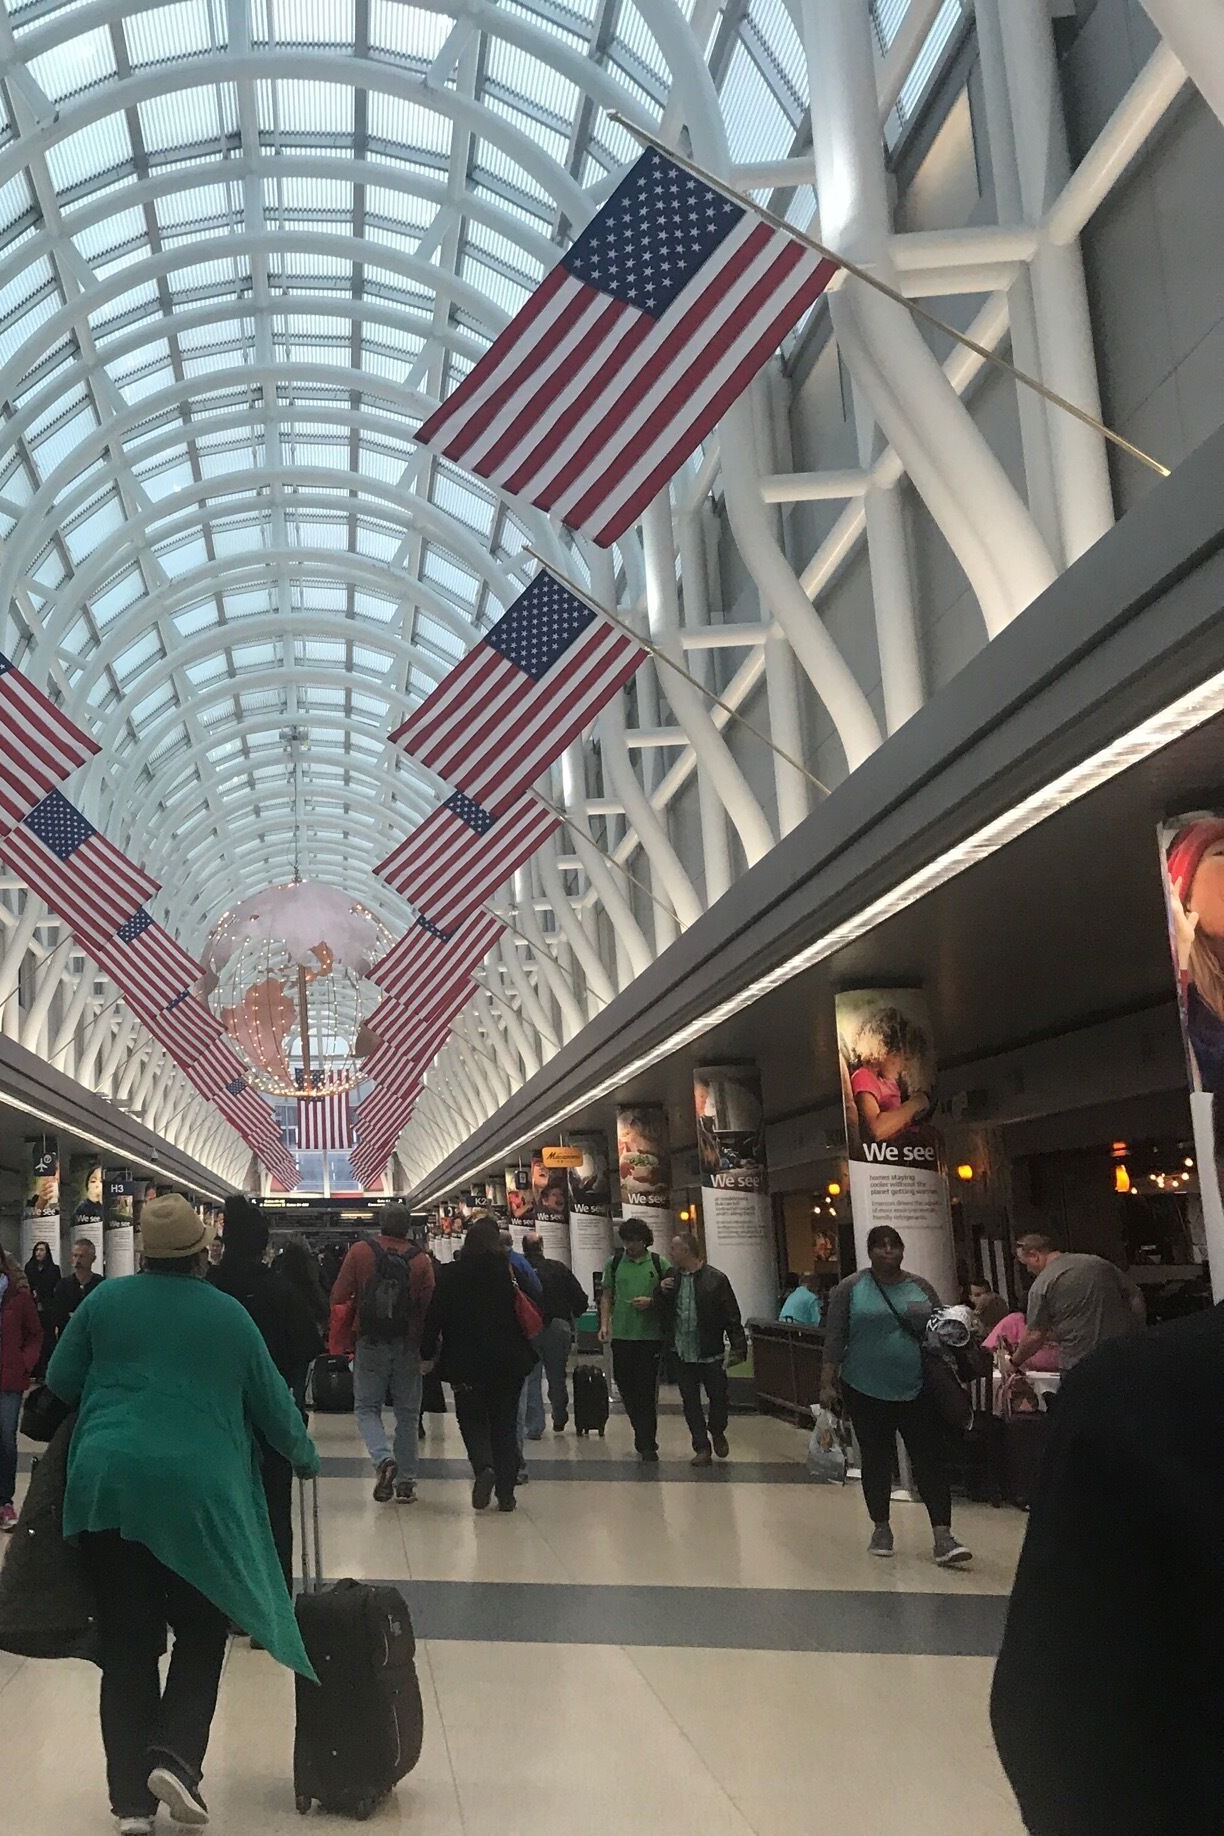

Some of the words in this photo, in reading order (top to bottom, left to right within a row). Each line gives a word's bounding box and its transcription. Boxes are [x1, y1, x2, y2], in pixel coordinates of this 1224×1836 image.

[862, 1141, 899, 1162] We
[903, 1146, 936, 1161] see
[710, 1173, 736, 1188] We
[737, 1175, 760, 1188] see
[110, 1184, 125, 1193] H3
[475, 1197, 487, 1206] K2
[628, 1193, 647, 1204] We
[42, 1208, 56, 1216] see
[574, 1204, 590, 1213] We
[77, 1214, 89, 1223] We
[537, 1212, 550, 1221] We
[511, 1218, 524, 1226] We
